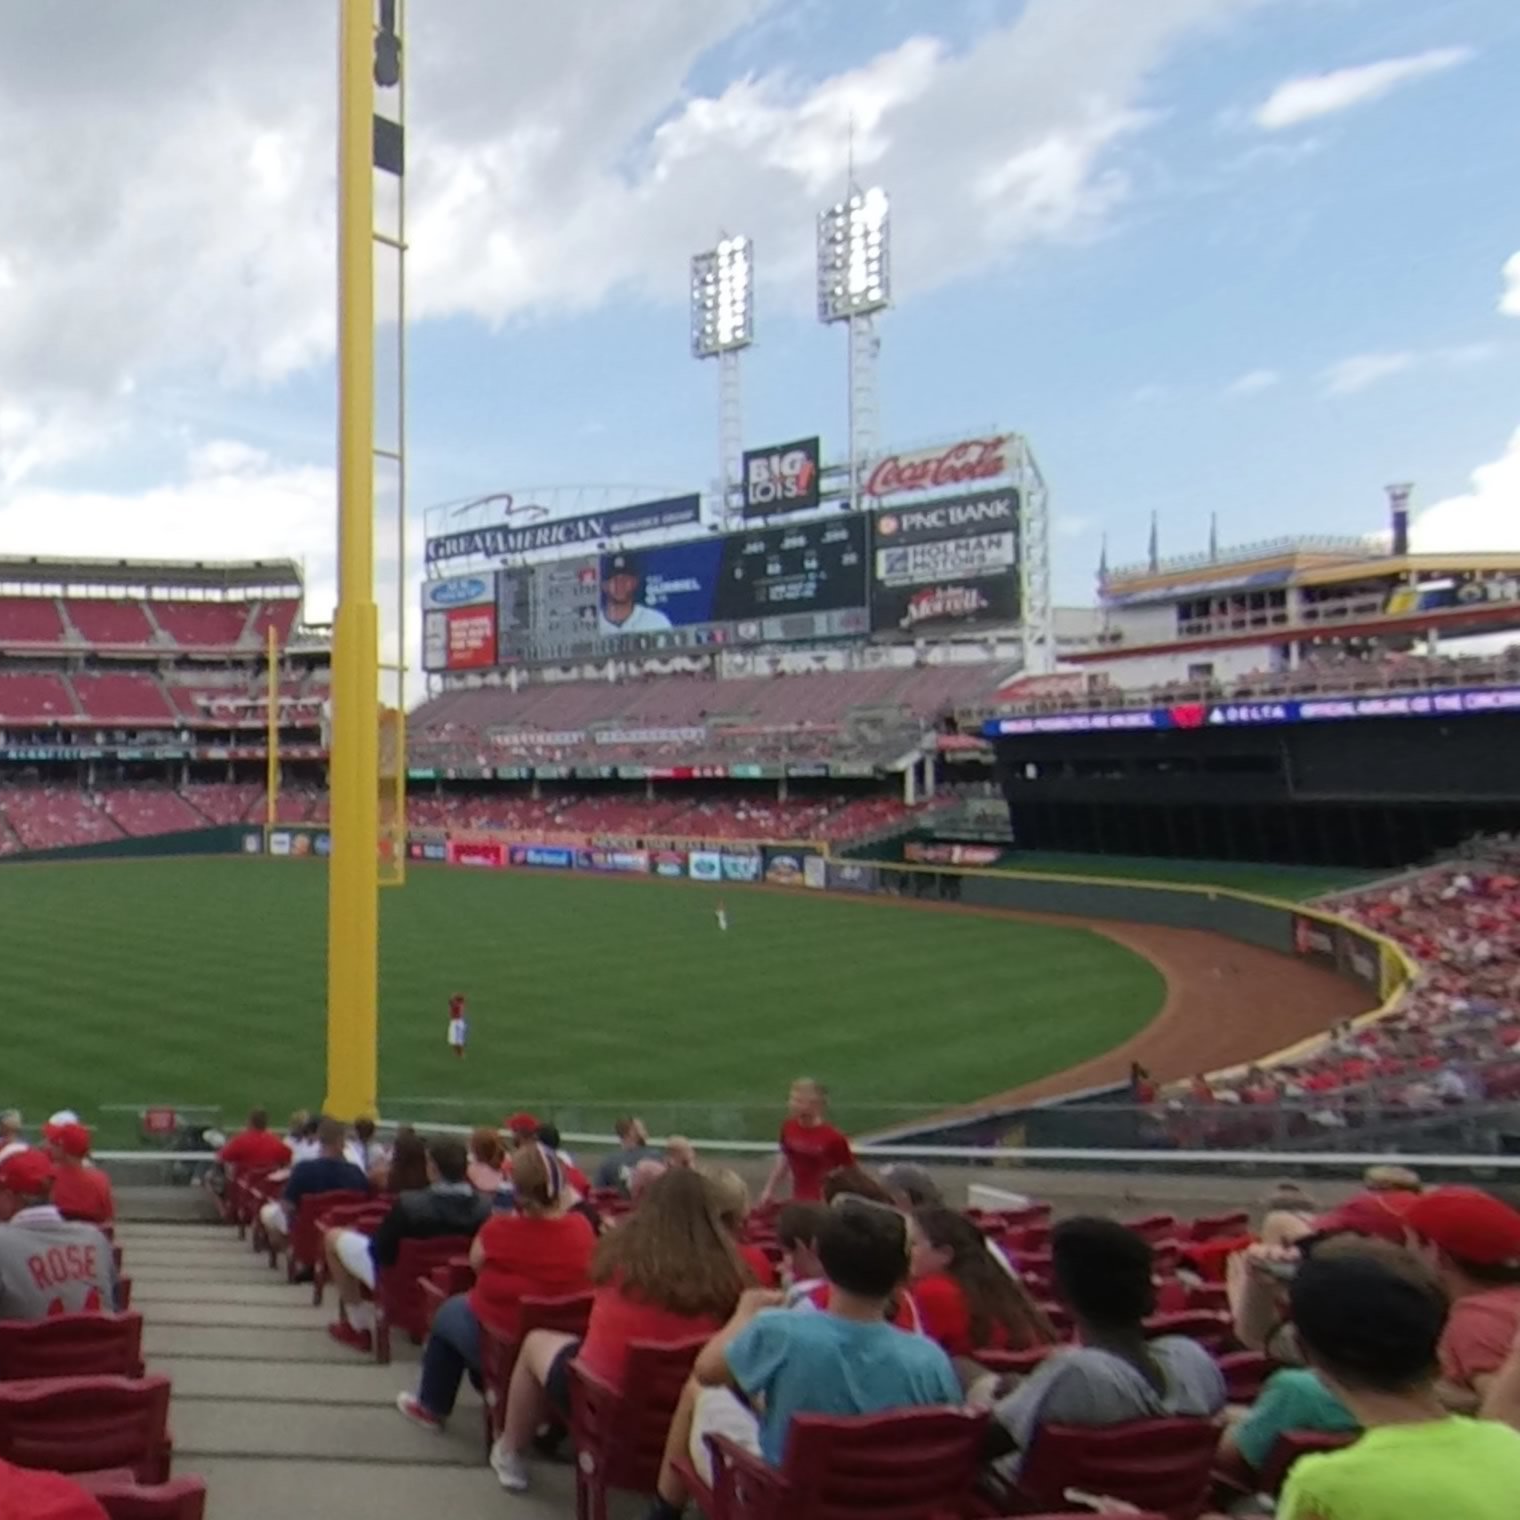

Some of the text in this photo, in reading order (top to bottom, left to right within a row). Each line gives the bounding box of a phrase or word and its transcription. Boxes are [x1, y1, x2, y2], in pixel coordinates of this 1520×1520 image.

[748, 451, 806, 484] BIG
[901, 499, 1011, 531] PNC BANK
[429, 526, 498, 561] GREAT
[489, 518, 605, 557] AMERICAN
[912, 536, 1002, 558] HOLMAN
[912, 552, 987, 570] MOTORS
[1226, 704, 1286, 721] DELTA
[27, 1245, 97, 1290] ROSE
